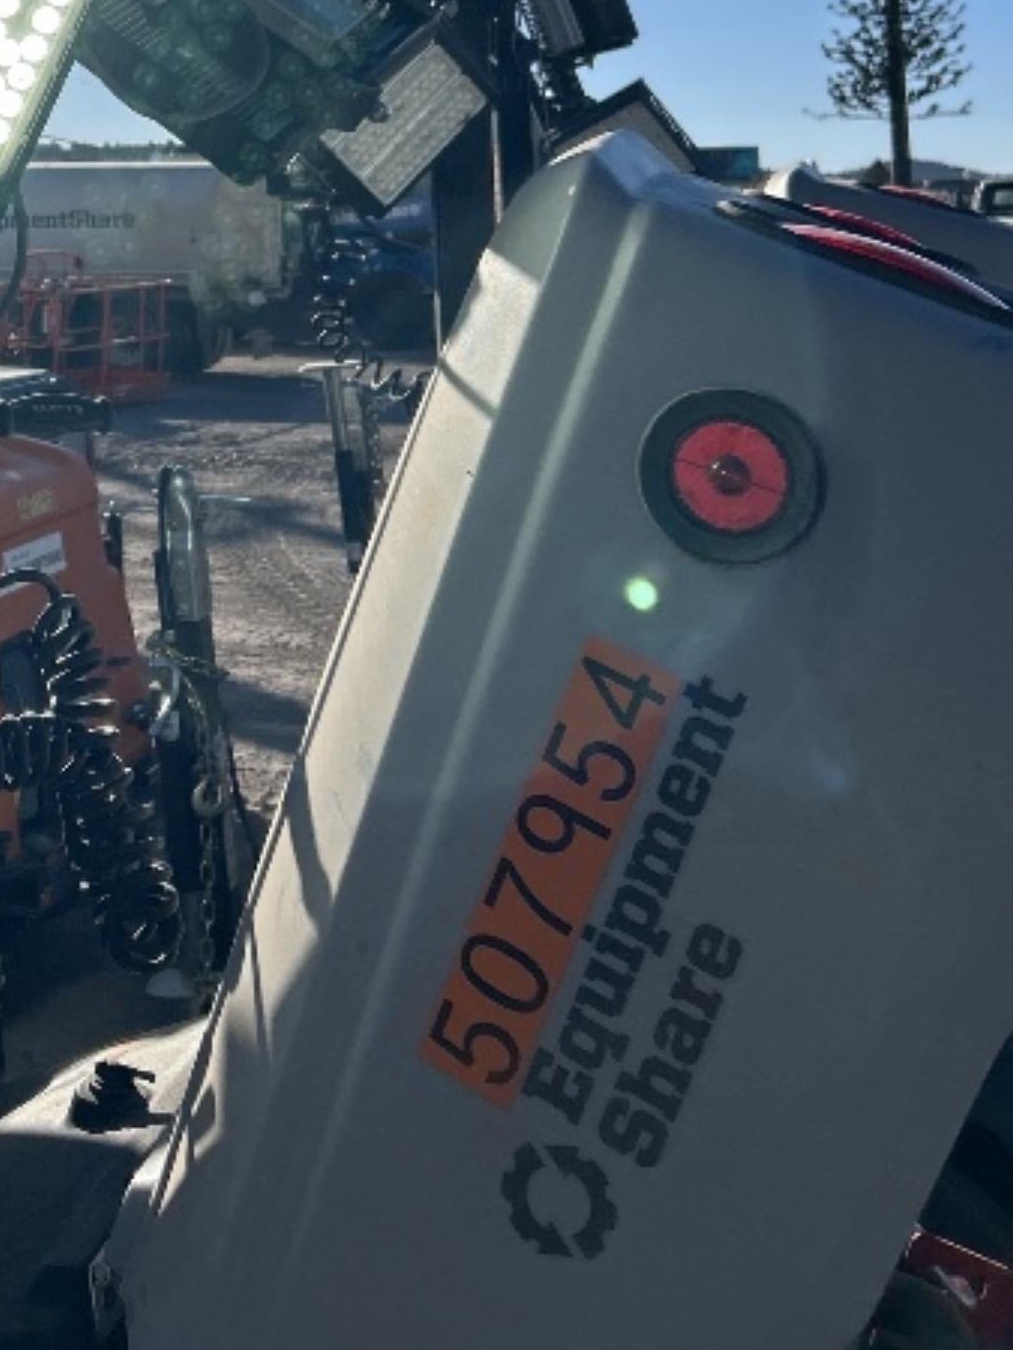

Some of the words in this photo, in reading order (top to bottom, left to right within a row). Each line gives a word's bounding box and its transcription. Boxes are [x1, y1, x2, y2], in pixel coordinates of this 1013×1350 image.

[426, 655, 668, 1087] 507954
[521, 674, 748, 1126] Equipment
[596, 922, 745, 1169] Share
